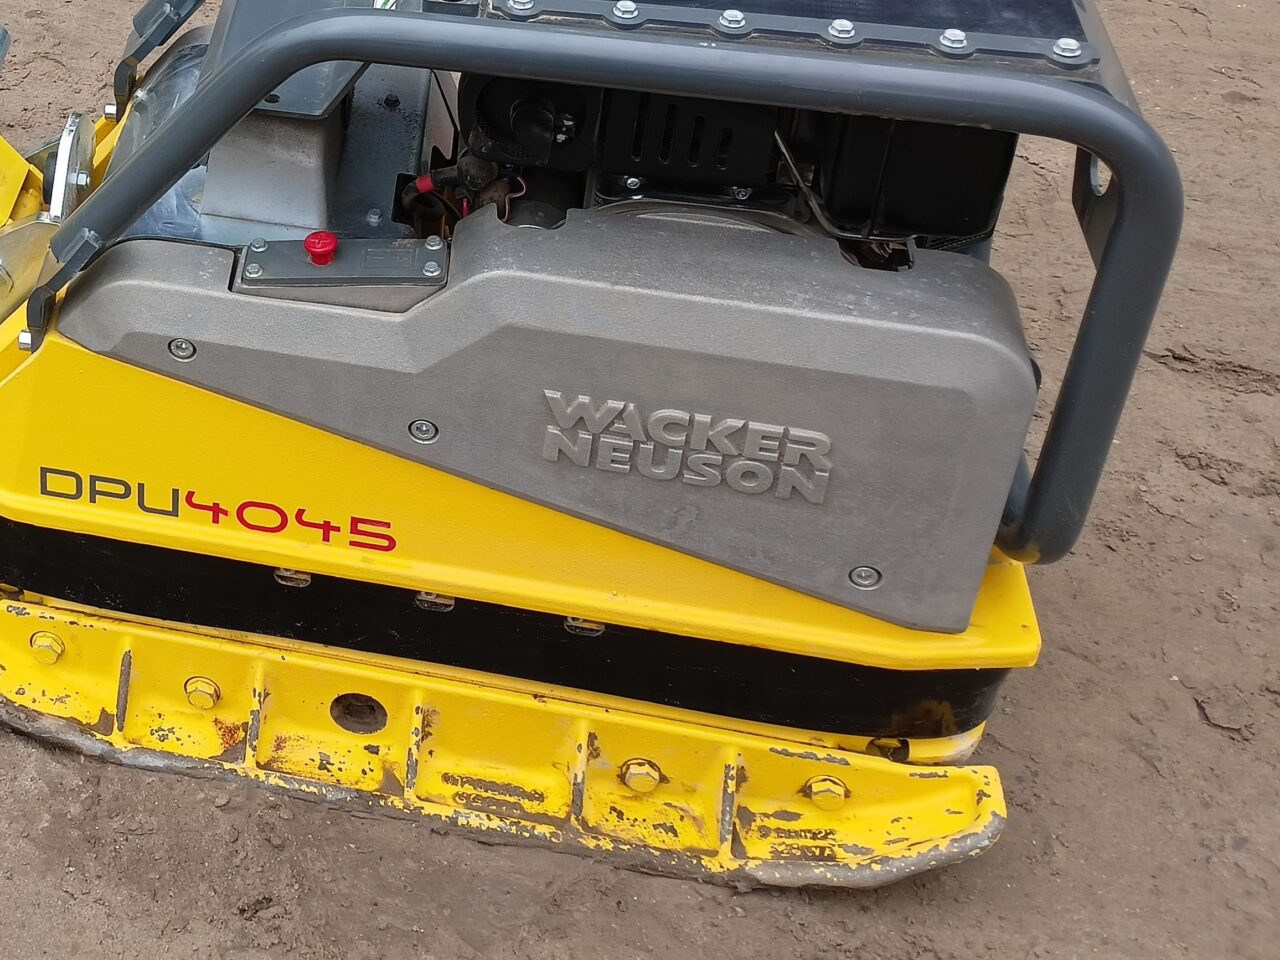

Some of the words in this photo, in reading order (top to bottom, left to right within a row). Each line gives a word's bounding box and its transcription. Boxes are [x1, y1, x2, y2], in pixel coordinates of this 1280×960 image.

[542, 424, 830, 505] NEUSON
[543, 389, 834, 471] WACKER
[39, 466, 397, 552] DPU4045
